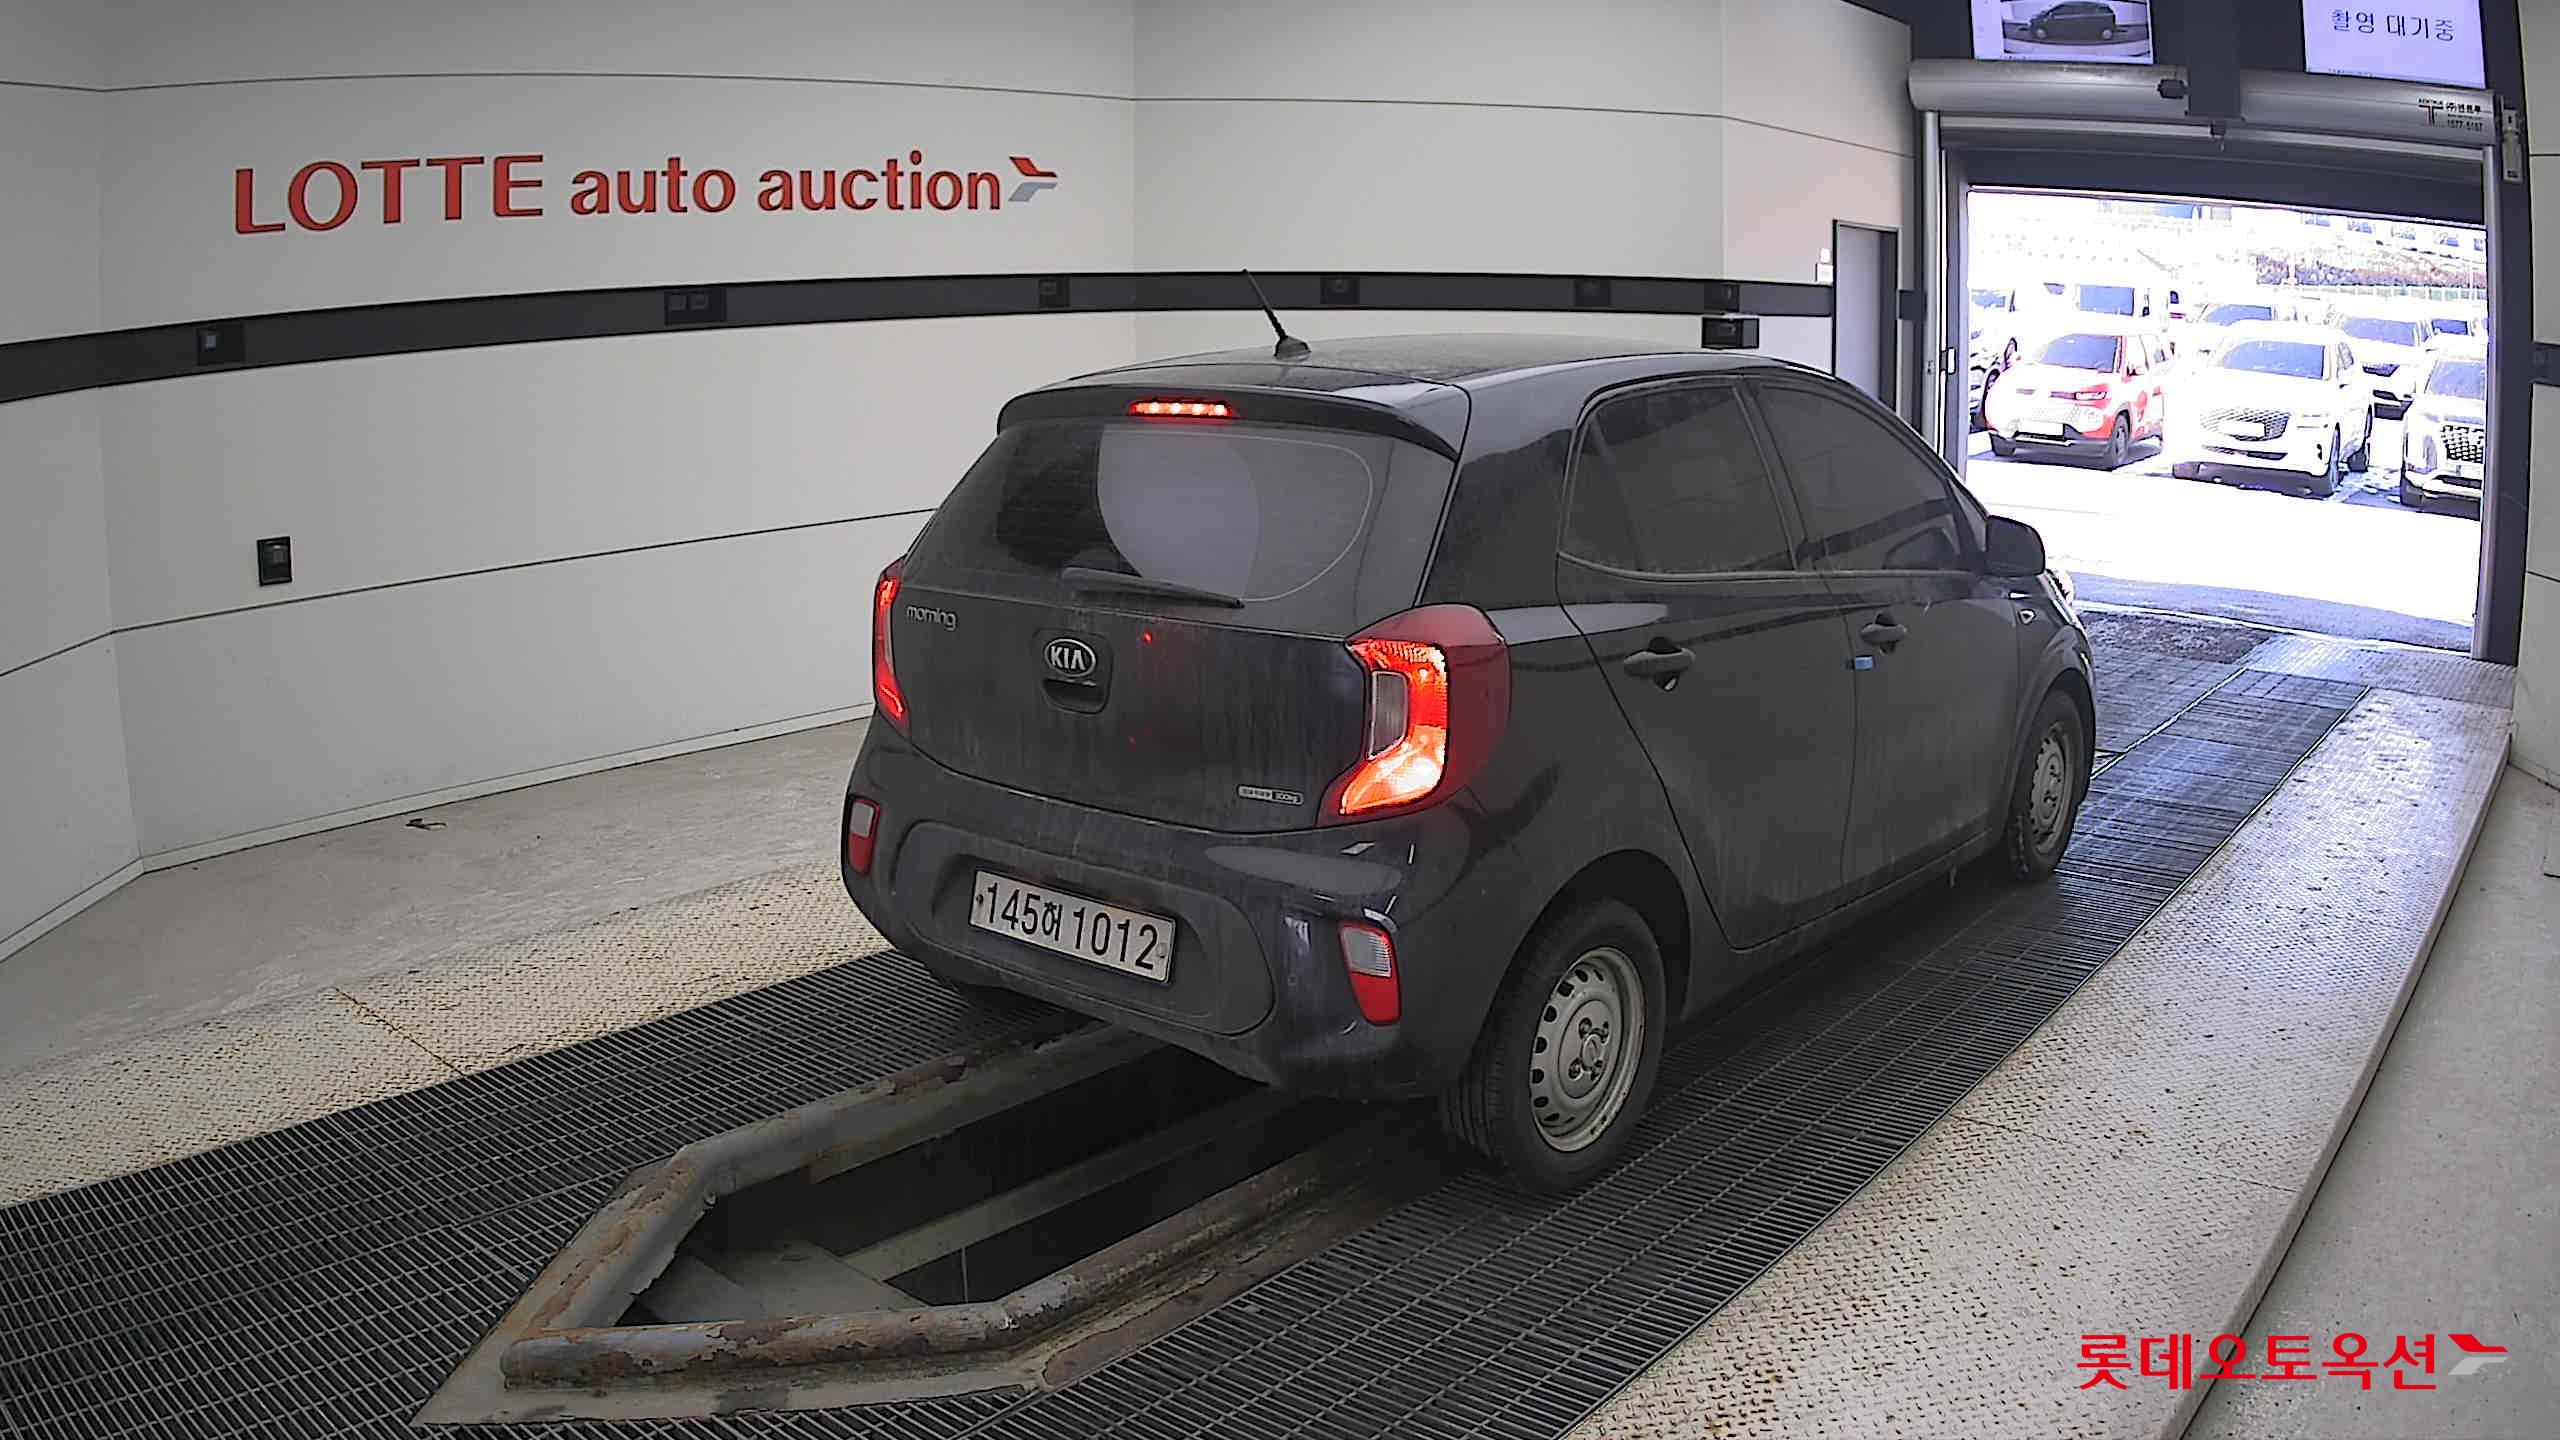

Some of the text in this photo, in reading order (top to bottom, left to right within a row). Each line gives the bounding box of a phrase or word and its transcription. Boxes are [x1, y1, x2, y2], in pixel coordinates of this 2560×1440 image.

[2331, 9, 2454, 42] 촬영 대기중
[235, 149, 1001, 234] LOTTE auto auction
[906, 606, 956, 631] morning
[1050, 645, 1086, 671] KIA
[987, 882, 1159, 970] 145허 1012
